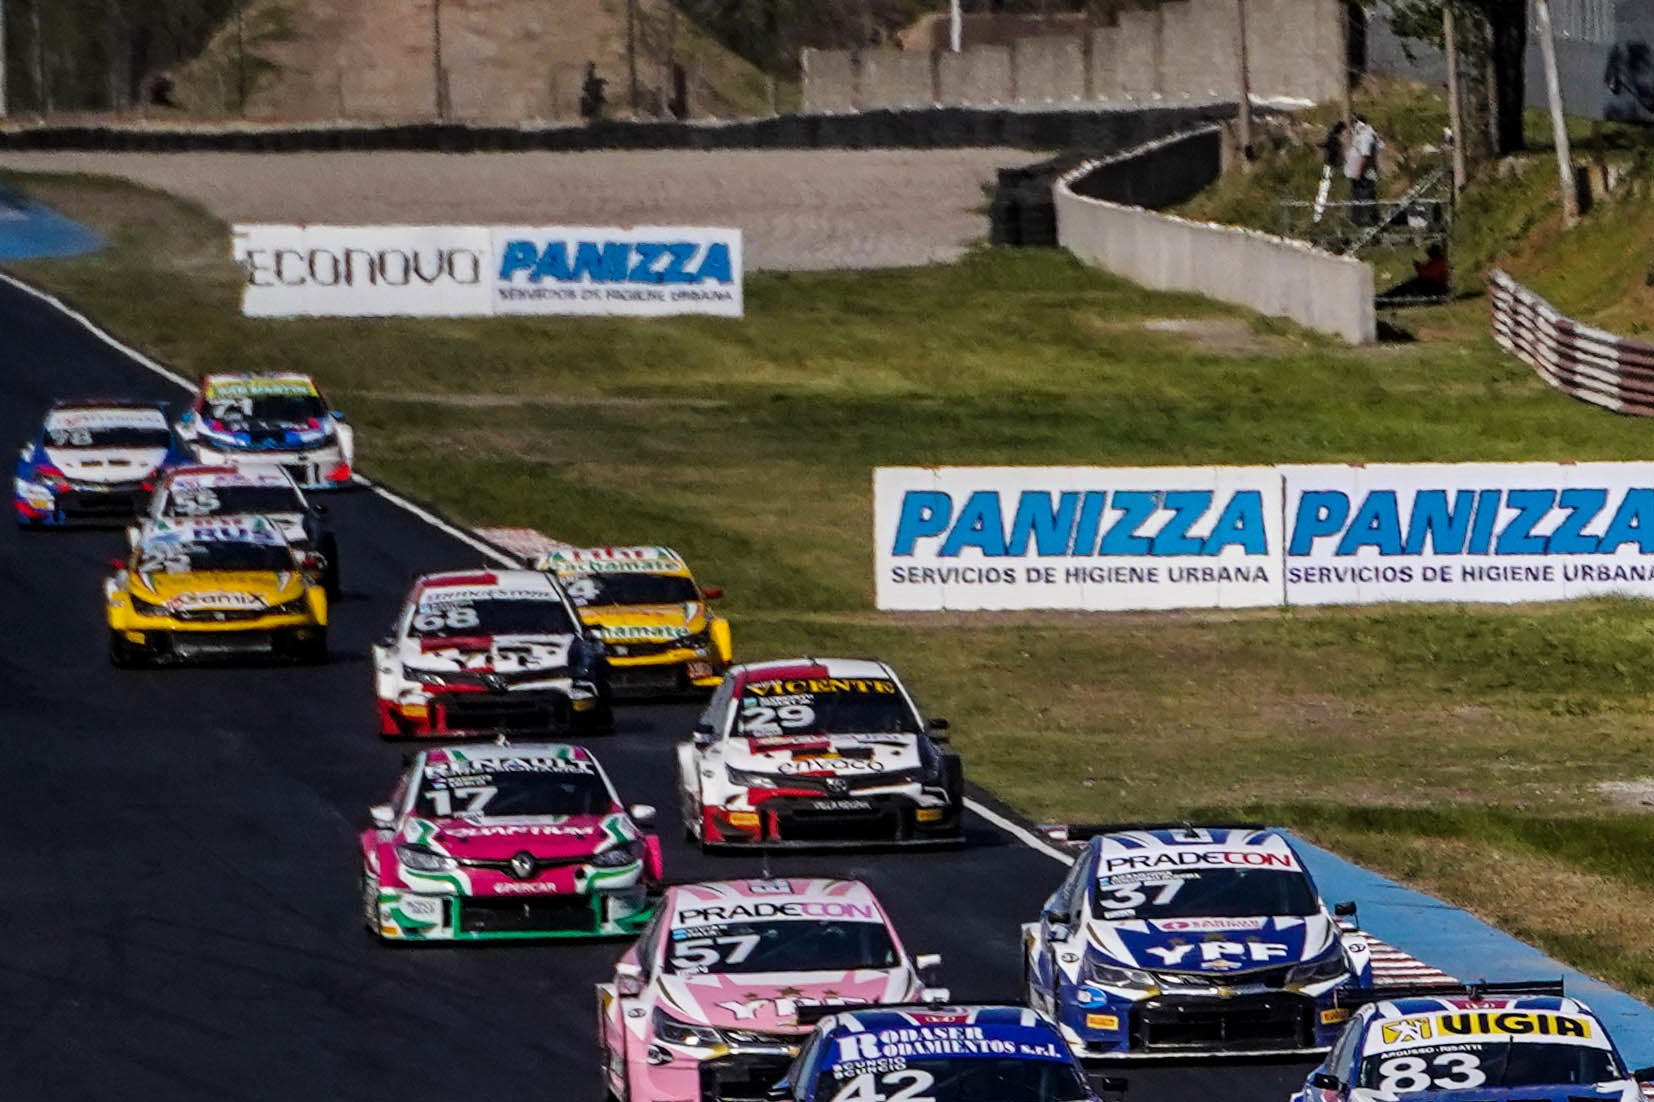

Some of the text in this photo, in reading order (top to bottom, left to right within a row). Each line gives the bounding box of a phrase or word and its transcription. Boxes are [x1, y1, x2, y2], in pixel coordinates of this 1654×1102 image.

[247, 248, 480, 287] ECONOVO
[499, 240, 734, 284] PANIZZA
[891, 489, 1269, 557] PANIZZA
[892, 565, 1269, 585] SERVICIOS DE HIGIENE URBANA
[1288, 565, 1413, 583] SERVICIOS
[1422, 565, 1453, 583] DE
[1462, 565, 1554, 582] HIGIENE
[413, 607, 480, 632] 68
[747, 679, 896, 697] VICENTE
[743, 705, 816, 732] 29
[425, 786, 498, 816] 17
[1107, 850, 1292, 872] PRADECON
[1100, 879, 1185, 909] 37
[678, 901, 873, 925] PRADECON
[669, 933, 761, 970] 57
[1146, 940, 1289, 966] YPF
[1441, 1012, 1585, 1038] VIGIA
[1379, 1052, 1487, 1093] 83
